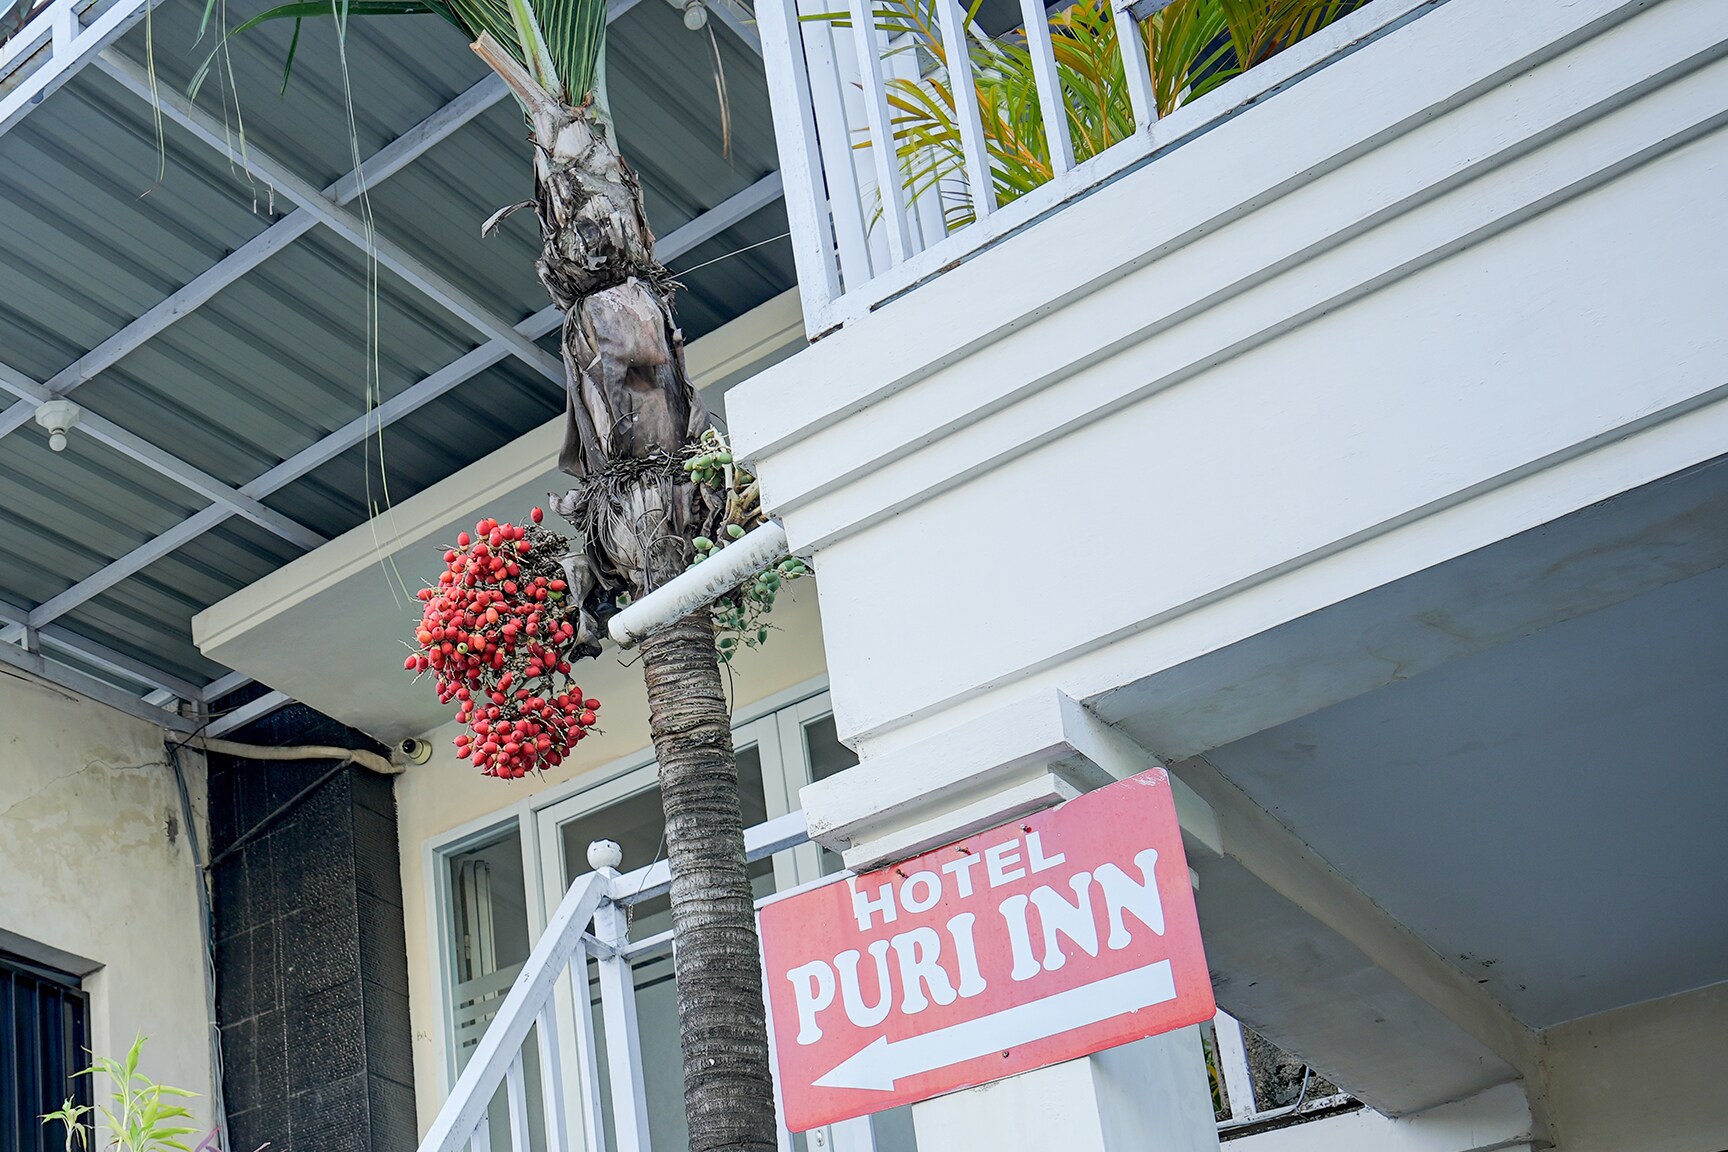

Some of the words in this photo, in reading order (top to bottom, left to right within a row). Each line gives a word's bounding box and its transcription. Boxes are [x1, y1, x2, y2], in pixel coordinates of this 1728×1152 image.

[786, 912, 988, 1045] PURI
[998, 848, 1165, 982] INN
[855, 830, 1066, 931] HOTEL
